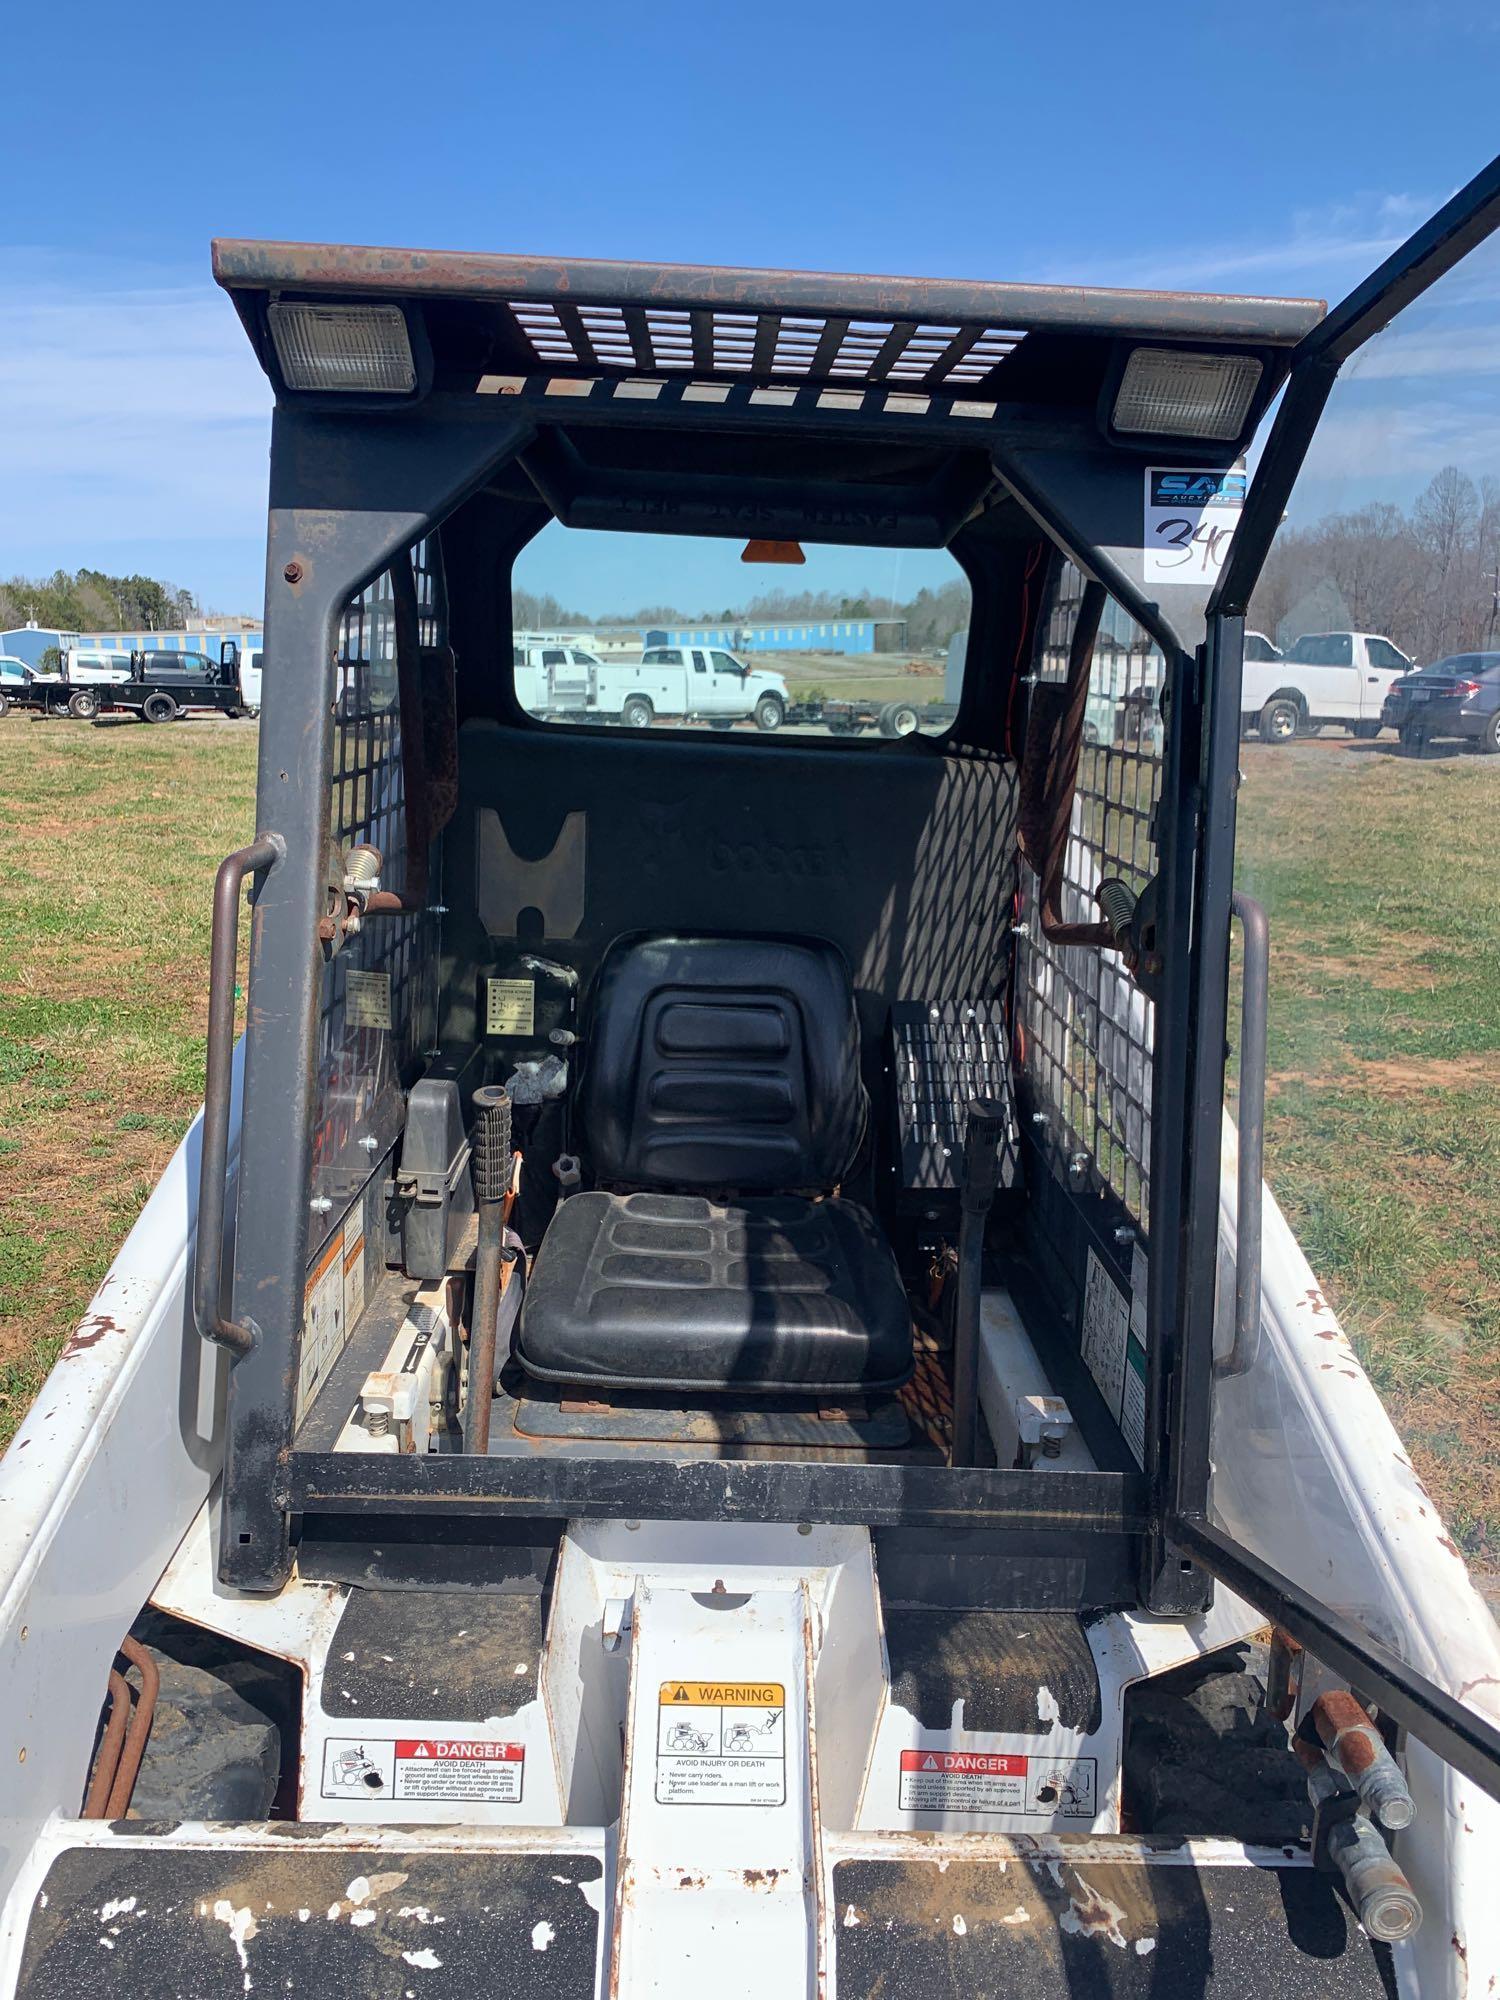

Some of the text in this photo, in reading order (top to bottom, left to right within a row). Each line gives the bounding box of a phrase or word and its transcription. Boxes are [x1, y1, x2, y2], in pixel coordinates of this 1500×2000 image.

[698, 1687, 774, 1702] WARNING
[436, 1743, 506, 1758] DANGER
[675, 1759, 766, 1768] AVOID INJURY OR DEATH
[944, 1756, 1008, 1771] DANGER
